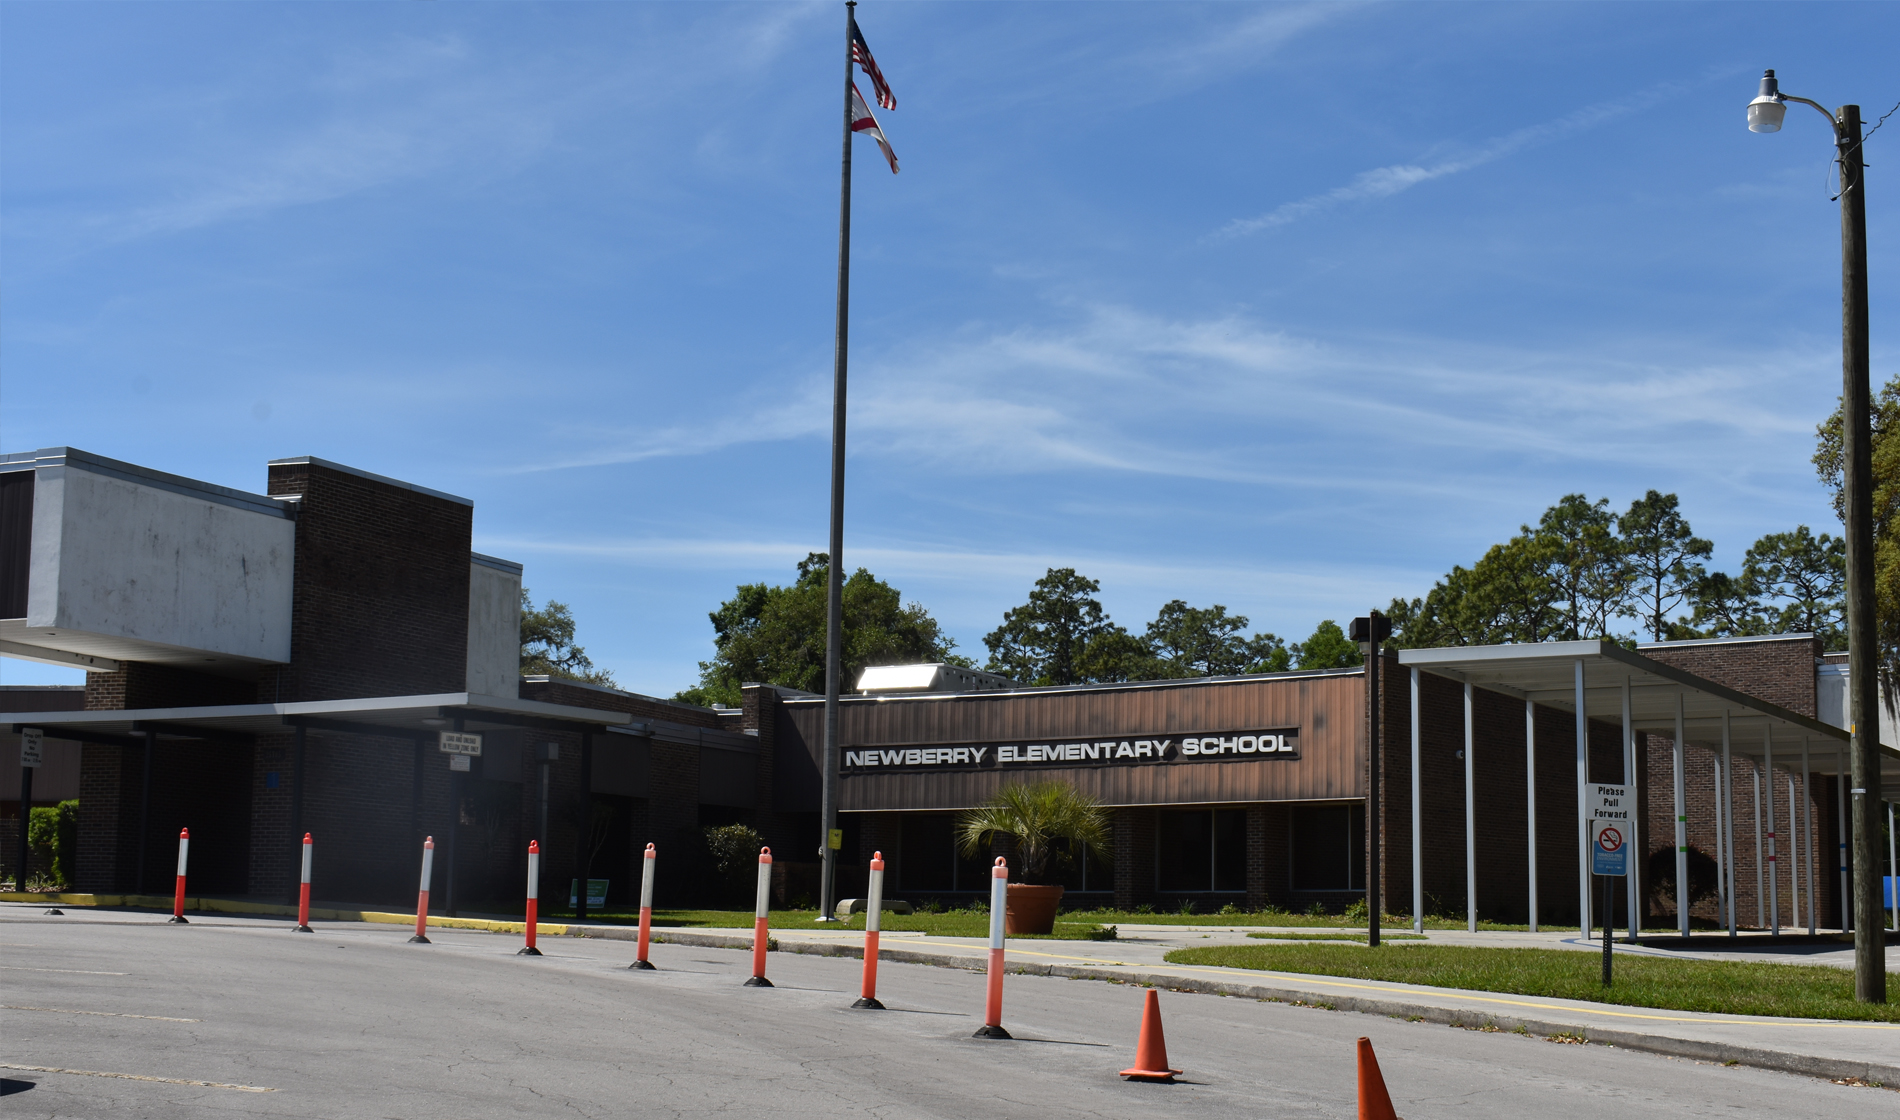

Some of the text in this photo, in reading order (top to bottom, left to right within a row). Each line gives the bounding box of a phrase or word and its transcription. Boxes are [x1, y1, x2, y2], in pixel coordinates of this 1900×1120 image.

[846, 735, 1293, 766] NEWBERRY ELEMENTARY SCHOOL
[1598, 786, 1625, 796] Please
[1603, 798, 1619, 807] Pull
[1594, 809, 1627, 818] Forward
